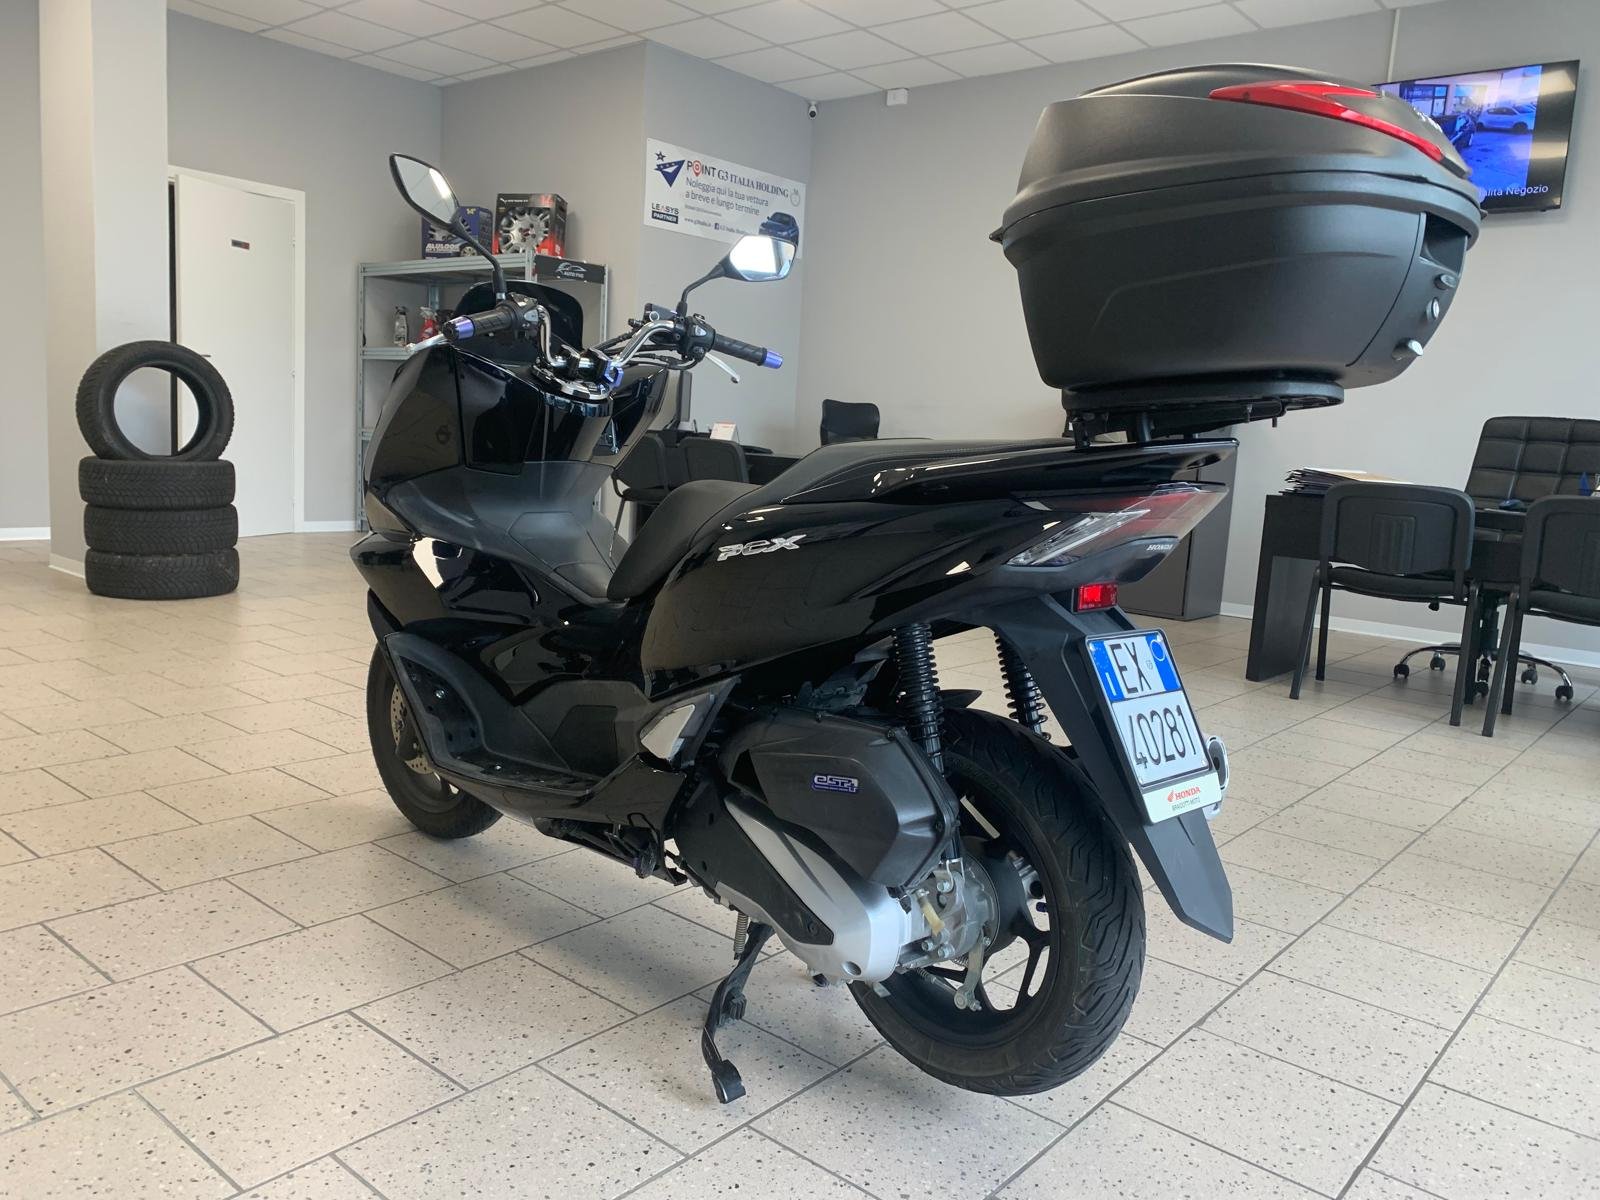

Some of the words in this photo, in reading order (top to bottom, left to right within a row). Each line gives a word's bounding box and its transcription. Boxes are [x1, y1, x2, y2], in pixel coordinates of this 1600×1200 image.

[686, 177, 716, 194] Noleggia
[717, 186, 727, 196] qui
[728, 188, 734, 197] la
[735, 191, 745, 200] tua
[746, 194, 769, 207] vettura
[687, 160, 717, 178] POINT
[718, 169, 729, 181] G3
[730, 174, 755, 190] ITALIA
[756, 181, 789, 198] HOLDING
[1505, 184, 1549, 197] Negozio
[652, 203, 679, 215] LEASYS
[685, 190, 690, 199] a
[691, 190, 711, 204] breve
[717, 196, 735, 211] lungo
[735, 203, 760, 216] termine
[653, 212, 678, 223] PARTNER
[717, 534, 806, 562] PCX
[1109, 642, 1153, 695] EX
[1128, 704, 1197, 770] 40281
[1175, 786, 1201, 801] HONDA
